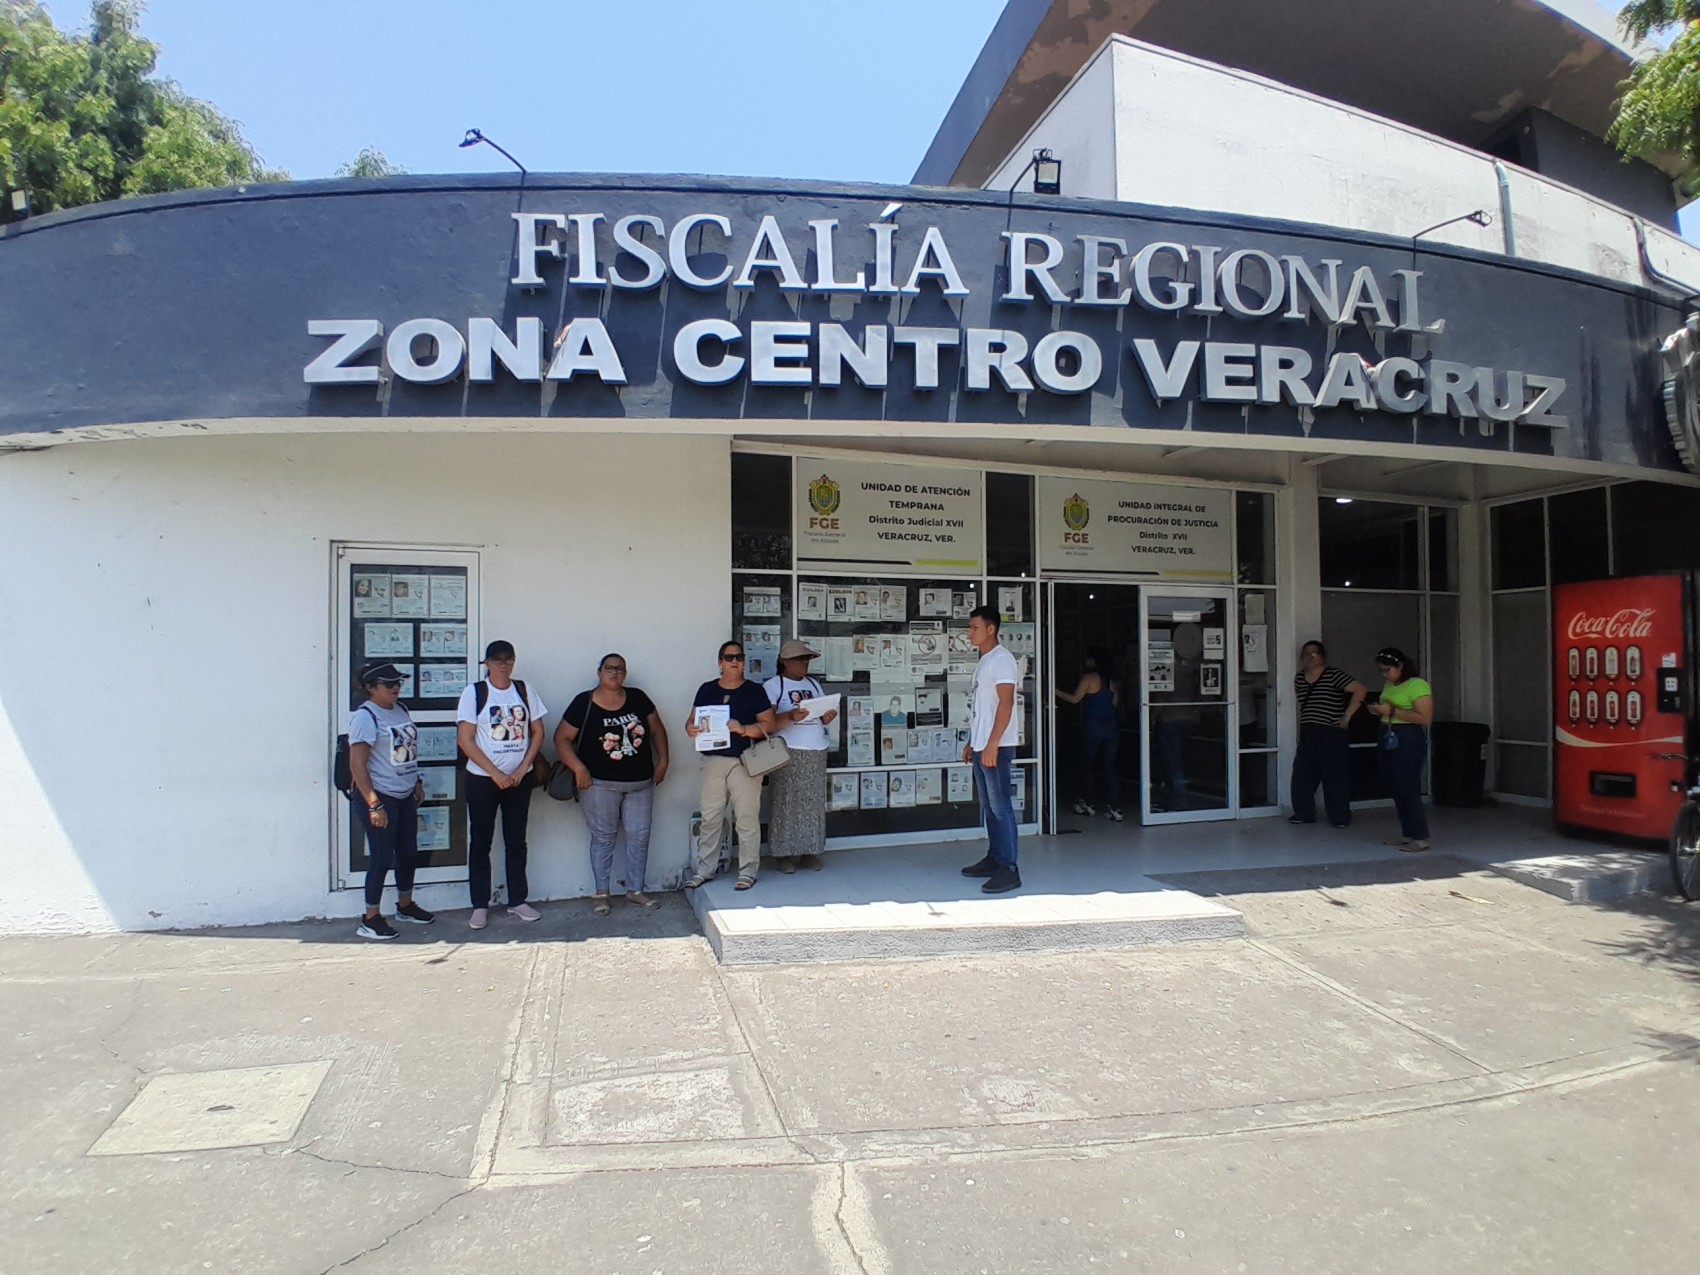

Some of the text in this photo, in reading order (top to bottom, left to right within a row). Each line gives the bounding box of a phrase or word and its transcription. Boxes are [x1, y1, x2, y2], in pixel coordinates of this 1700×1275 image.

[510, 202, 1446, 335] FISCALÍA REGIONAL
[303, 315, 1568, 429] ZONA CENTRO VERACRUZ
[861, 482, 971, 497] UNIDAD DE ATENCIÓN
[888, 500, 945, 511] TEMPRANA
[1118, 500, 1206, 513] UNIDAD INTEGRAL DE
[809, 516, 840, 530] FGE
[868, 515, 964, 528] Distrito Judicial XVII
[1107, 514, 1219, 528] PROCURACIÓN DE JUSTICIA
[877, 531, 956, 544] VERACRUZ, VER.
[1064, 532, 1089, 544] FGE
[1139, 531, 1187, 541] Distrito XVII
[1178, 546, 1196, 555] VER.
[1568, 607, 1657, 640] Coca-Cola
[603, 712, 639, 727] PARIS
